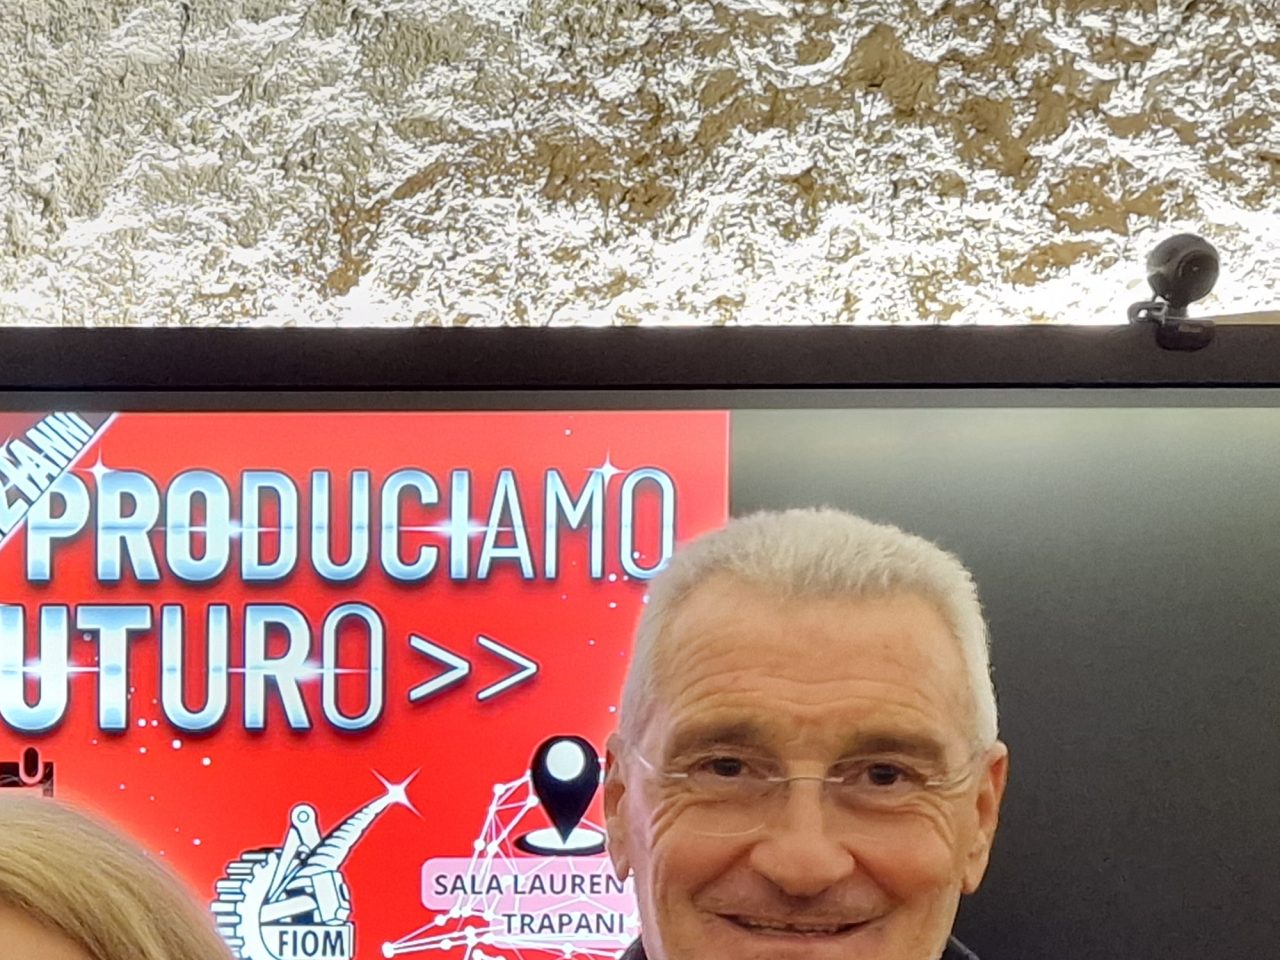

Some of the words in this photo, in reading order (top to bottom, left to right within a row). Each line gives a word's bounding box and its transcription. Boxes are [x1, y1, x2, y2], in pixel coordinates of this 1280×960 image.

[24, 467, 676, 581] PRODUCIAMO
[434, 874, 503, 895] SALA
[503, 913, 625, 934] TRAPANI
[279, 930, 345, 957] FIOM
